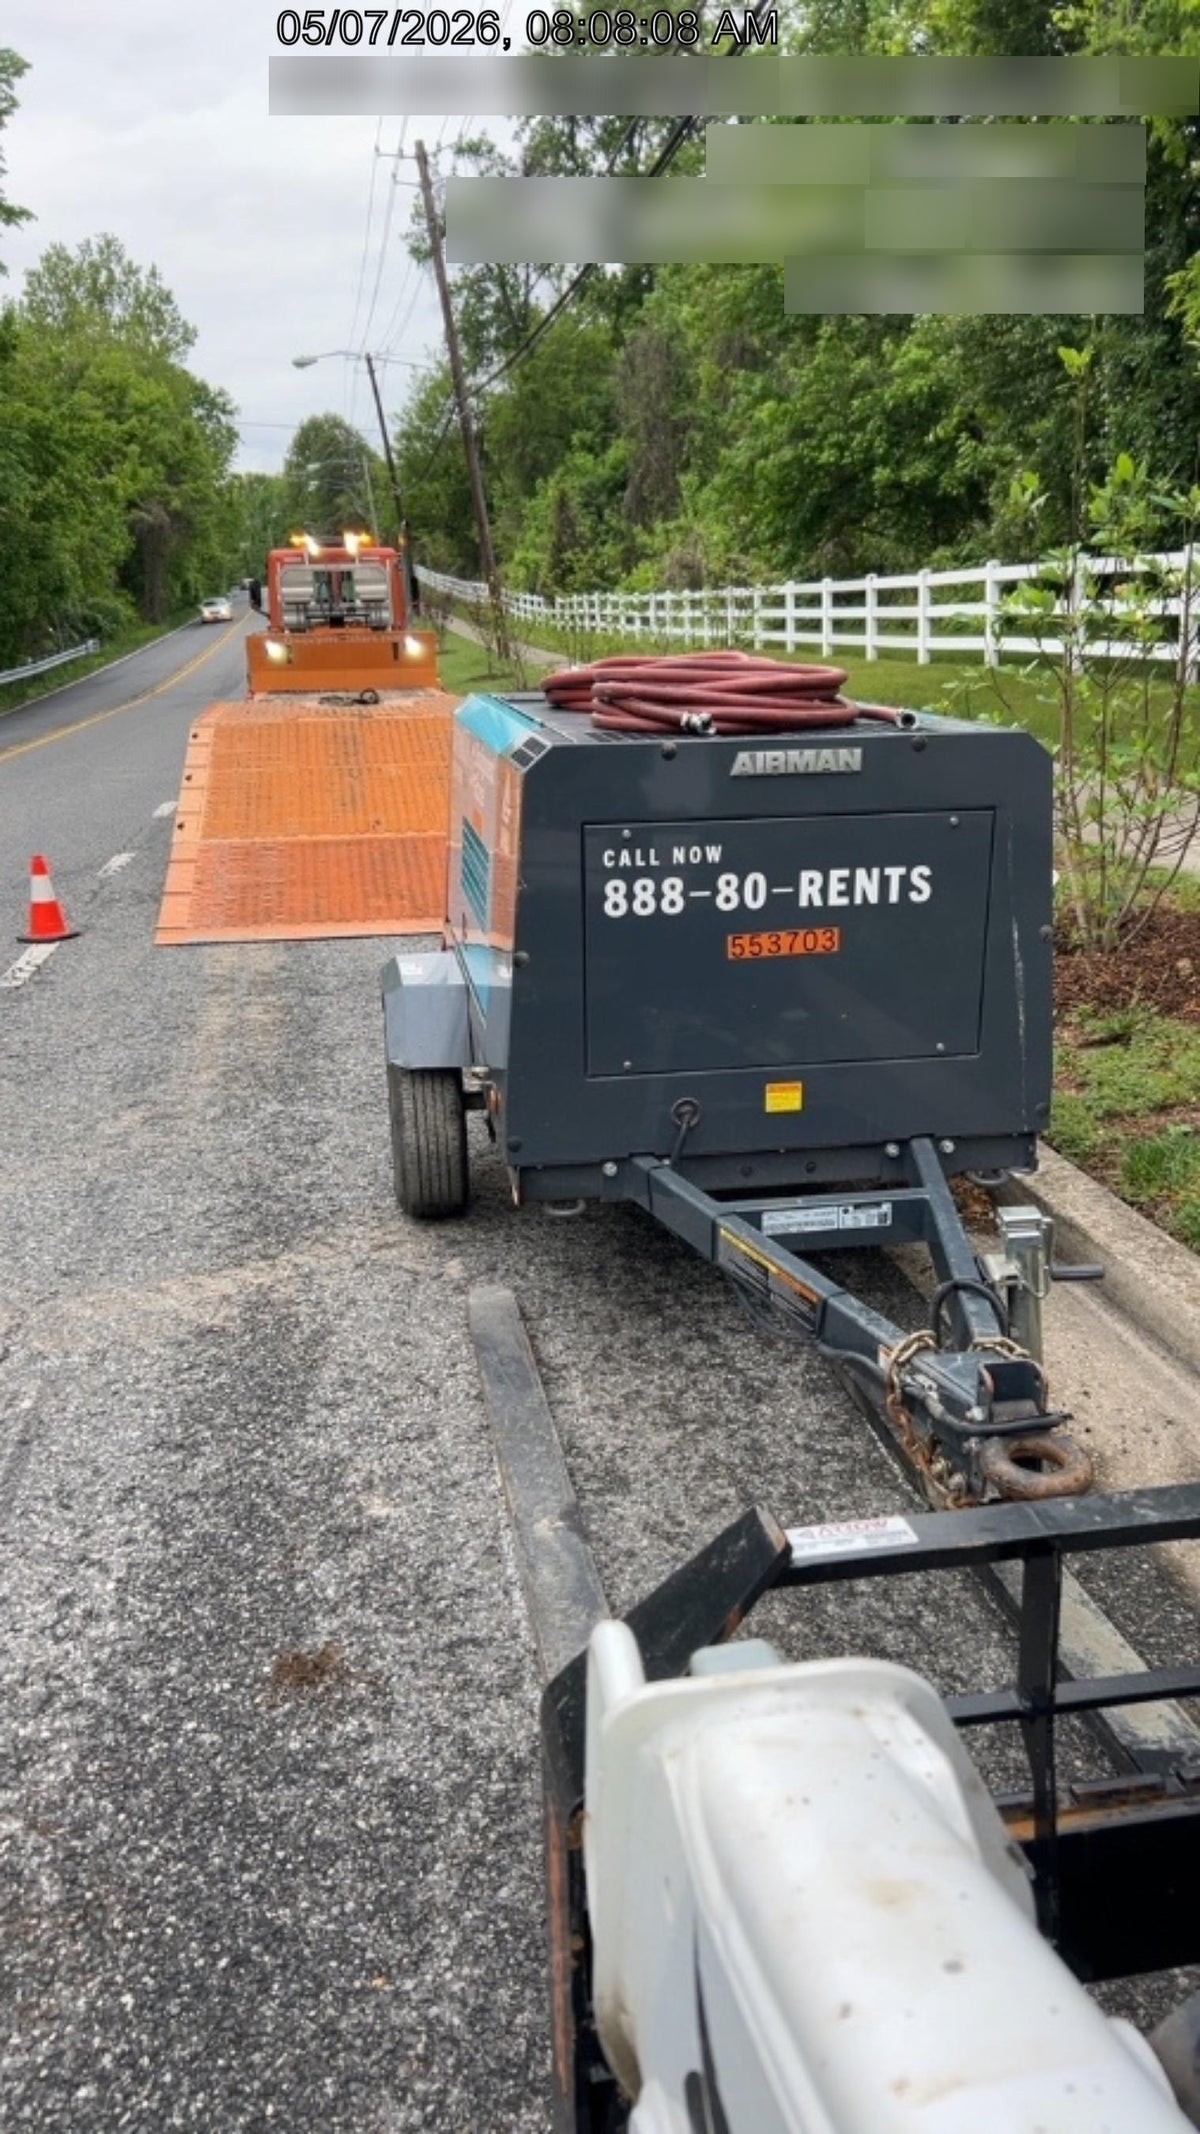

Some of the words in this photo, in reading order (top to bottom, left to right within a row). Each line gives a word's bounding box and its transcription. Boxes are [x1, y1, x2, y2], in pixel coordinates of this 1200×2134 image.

[730, 748, 862, 776] AIRMAN
[603, 848, 660, 868] CALL
[672, 844, 722, 865] NOW
[603, 864, 933, 918] 888-80-RENTS
[731, 928, 836, 957] 553703
